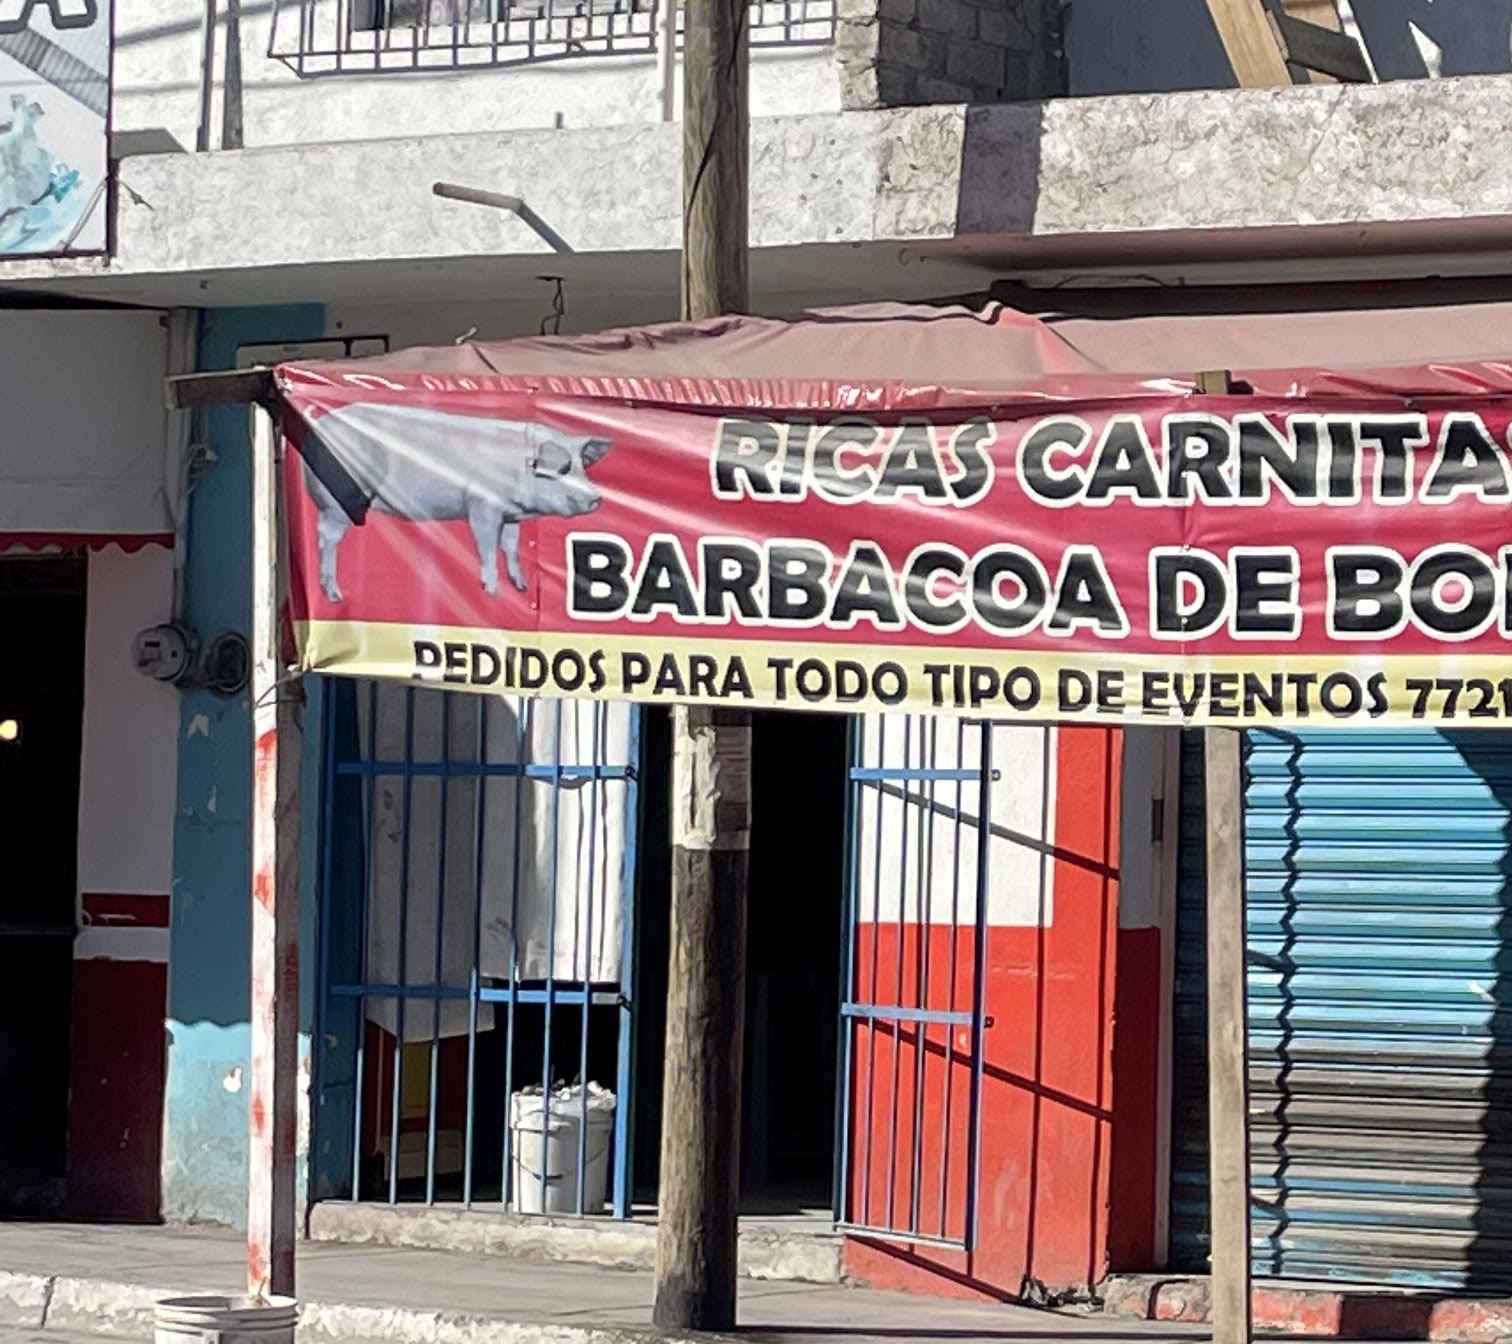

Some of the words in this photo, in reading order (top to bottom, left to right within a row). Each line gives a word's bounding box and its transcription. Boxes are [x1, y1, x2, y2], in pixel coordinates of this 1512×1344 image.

[710, 415, 996, 508] RICAS
[565, 533, 1129, 639] BARBACOA
[1149, 545, 1300, 640] DE
[411, 640, 607, 694] PEDIDOS
[620, 652, 754, 699] PARA
[767, 657, 909, 706] TODO
[924, 662, 1042, 711] TIPO
[1057, 666, 1127, 713] DE
[1142, 669, 1390, 719] EVENTOS
